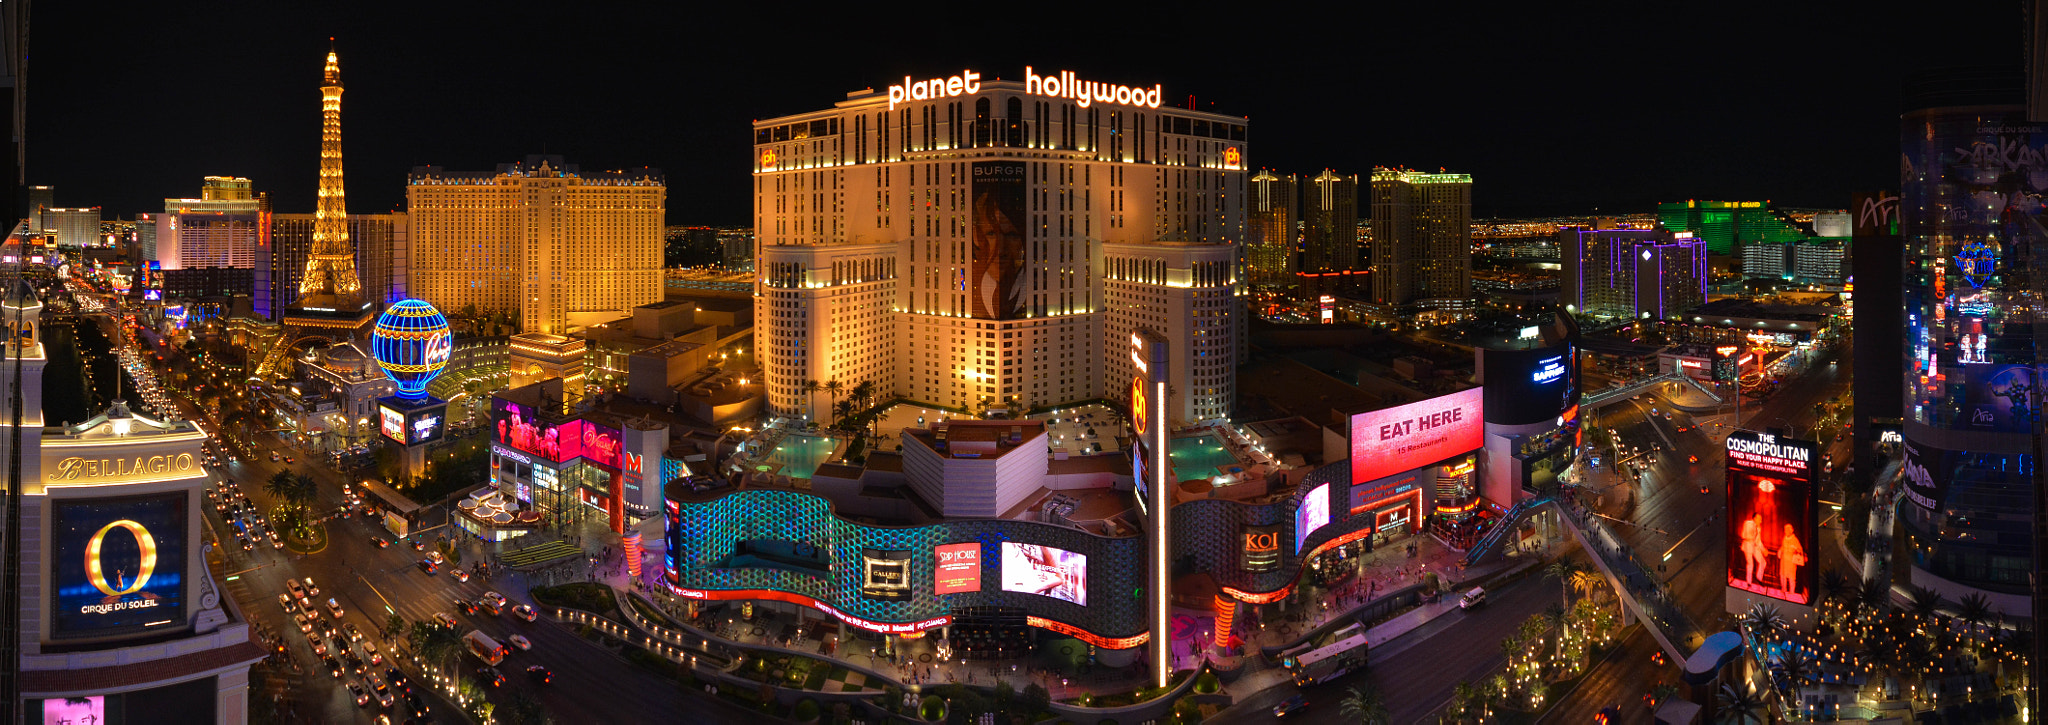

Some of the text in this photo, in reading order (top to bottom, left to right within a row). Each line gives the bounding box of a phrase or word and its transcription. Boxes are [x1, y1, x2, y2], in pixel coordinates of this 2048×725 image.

[889, 69, 981, 110] planet
[1025, 66, 1161, 108] hollywood
[974, 166, 1024, 176] BURGR
[1860, 197, 1900, 228] Ari
[425, 332, 450, 371] Paris
[1380, 407, 1462, 441] EAT HERE
[1972, 408, 1994, 423] Aria
[1397, 436, 1448, 454] 15 Restaurants
[1758, 433, 1775, 443] THE
[1881, 430, 1902, 442] Aria
[1727, 437, 1808, 461] COSMOPOLITAN
[1730, 450, 1744, 459] FIND
[1745, 453, 1761, 461] YOUR
[1762, 456, 1783, 466] HAPPY
[49, 452, 193, 480] BELLAGIO
[626, 451, 643, 474] M
[1390, 511, 1398, 521] M
[1246, 532, 1278, 549] KOI
[81, 599, 159, 614] CIRQUE DU SOLEIL
